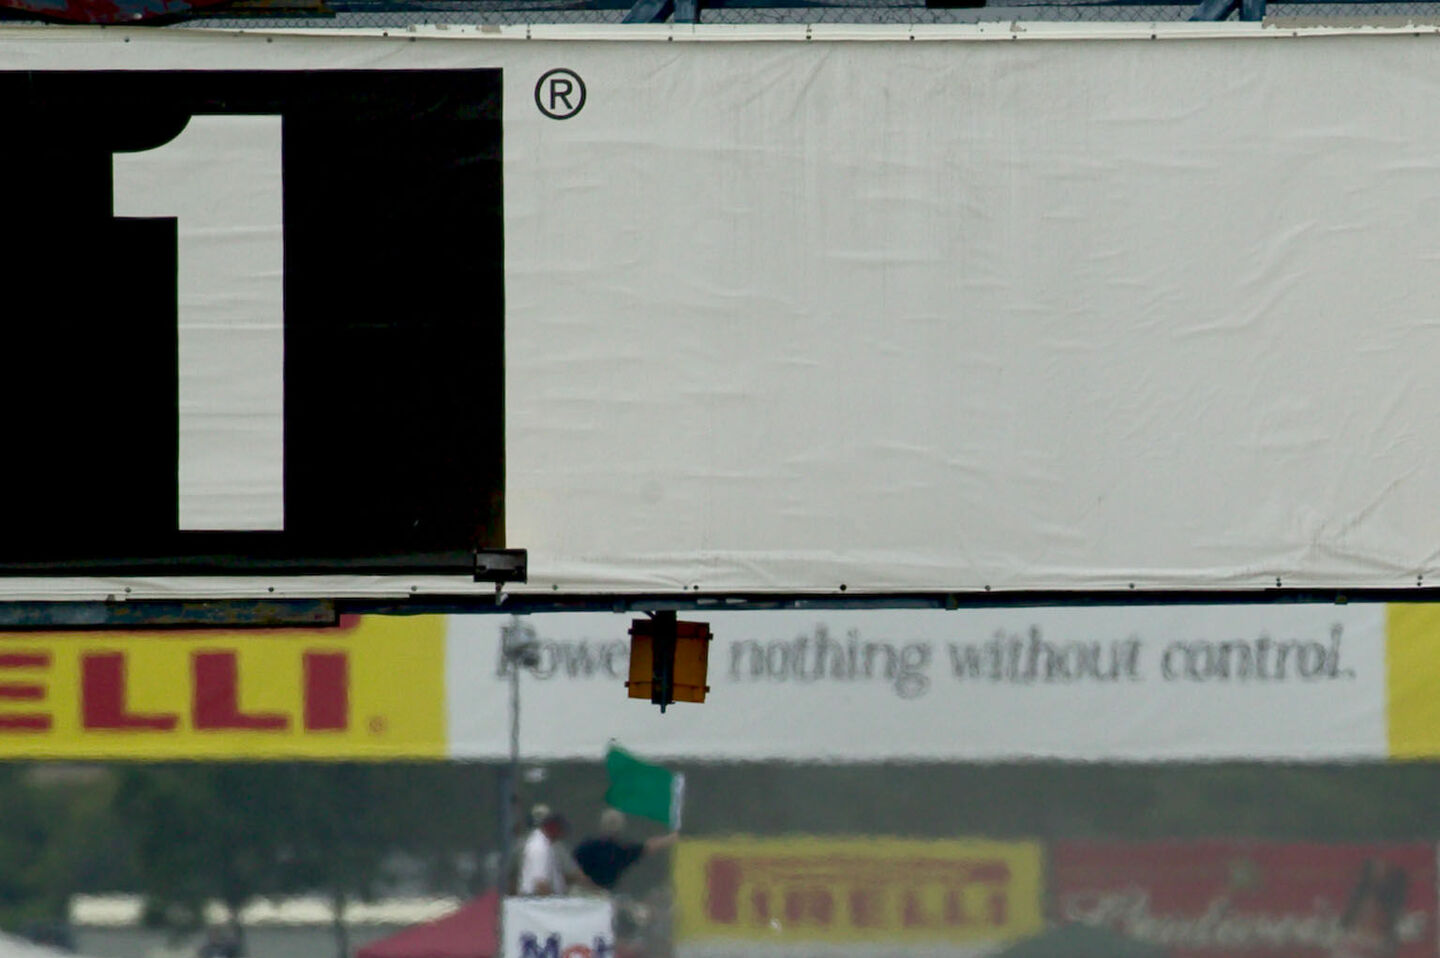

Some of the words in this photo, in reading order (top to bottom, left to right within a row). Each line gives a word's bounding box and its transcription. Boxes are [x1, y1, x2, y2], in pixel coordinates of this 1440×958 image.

[112, 114, 284, 531] 1
[728, 622, 931, 698] nothing
[947, 623, 1142, 682] without
[1160, 622, 1355, 682] control.
